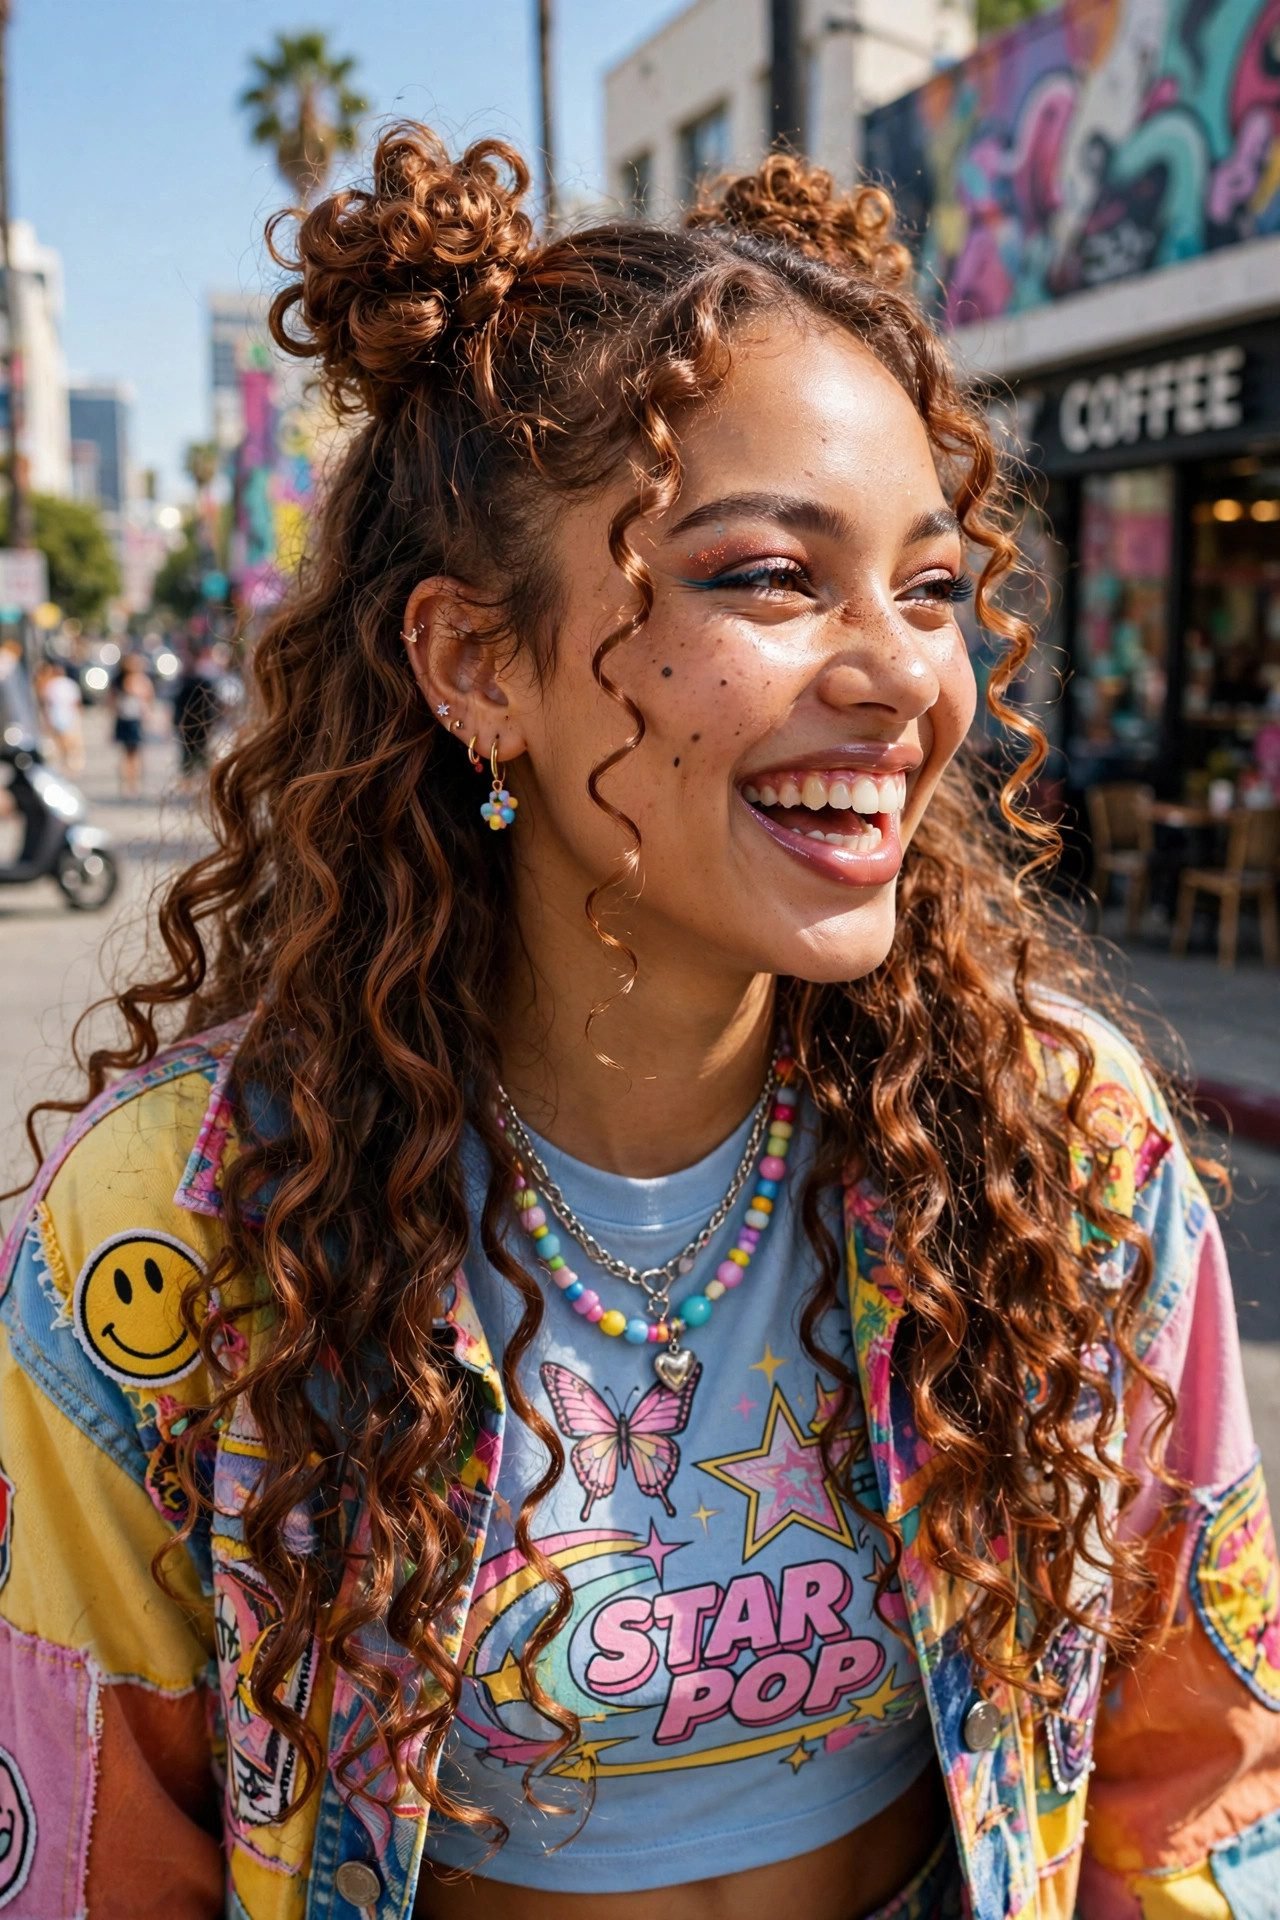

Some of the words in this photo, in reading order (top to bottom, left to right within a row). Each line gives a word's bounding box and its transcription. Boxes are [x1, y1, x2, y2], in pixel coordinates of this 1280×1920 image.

[1060, 346, 1245, 453] COFFEE
[586, 1560, 853, 1695] STAR
[653, 1636, 886, 1745] POP
